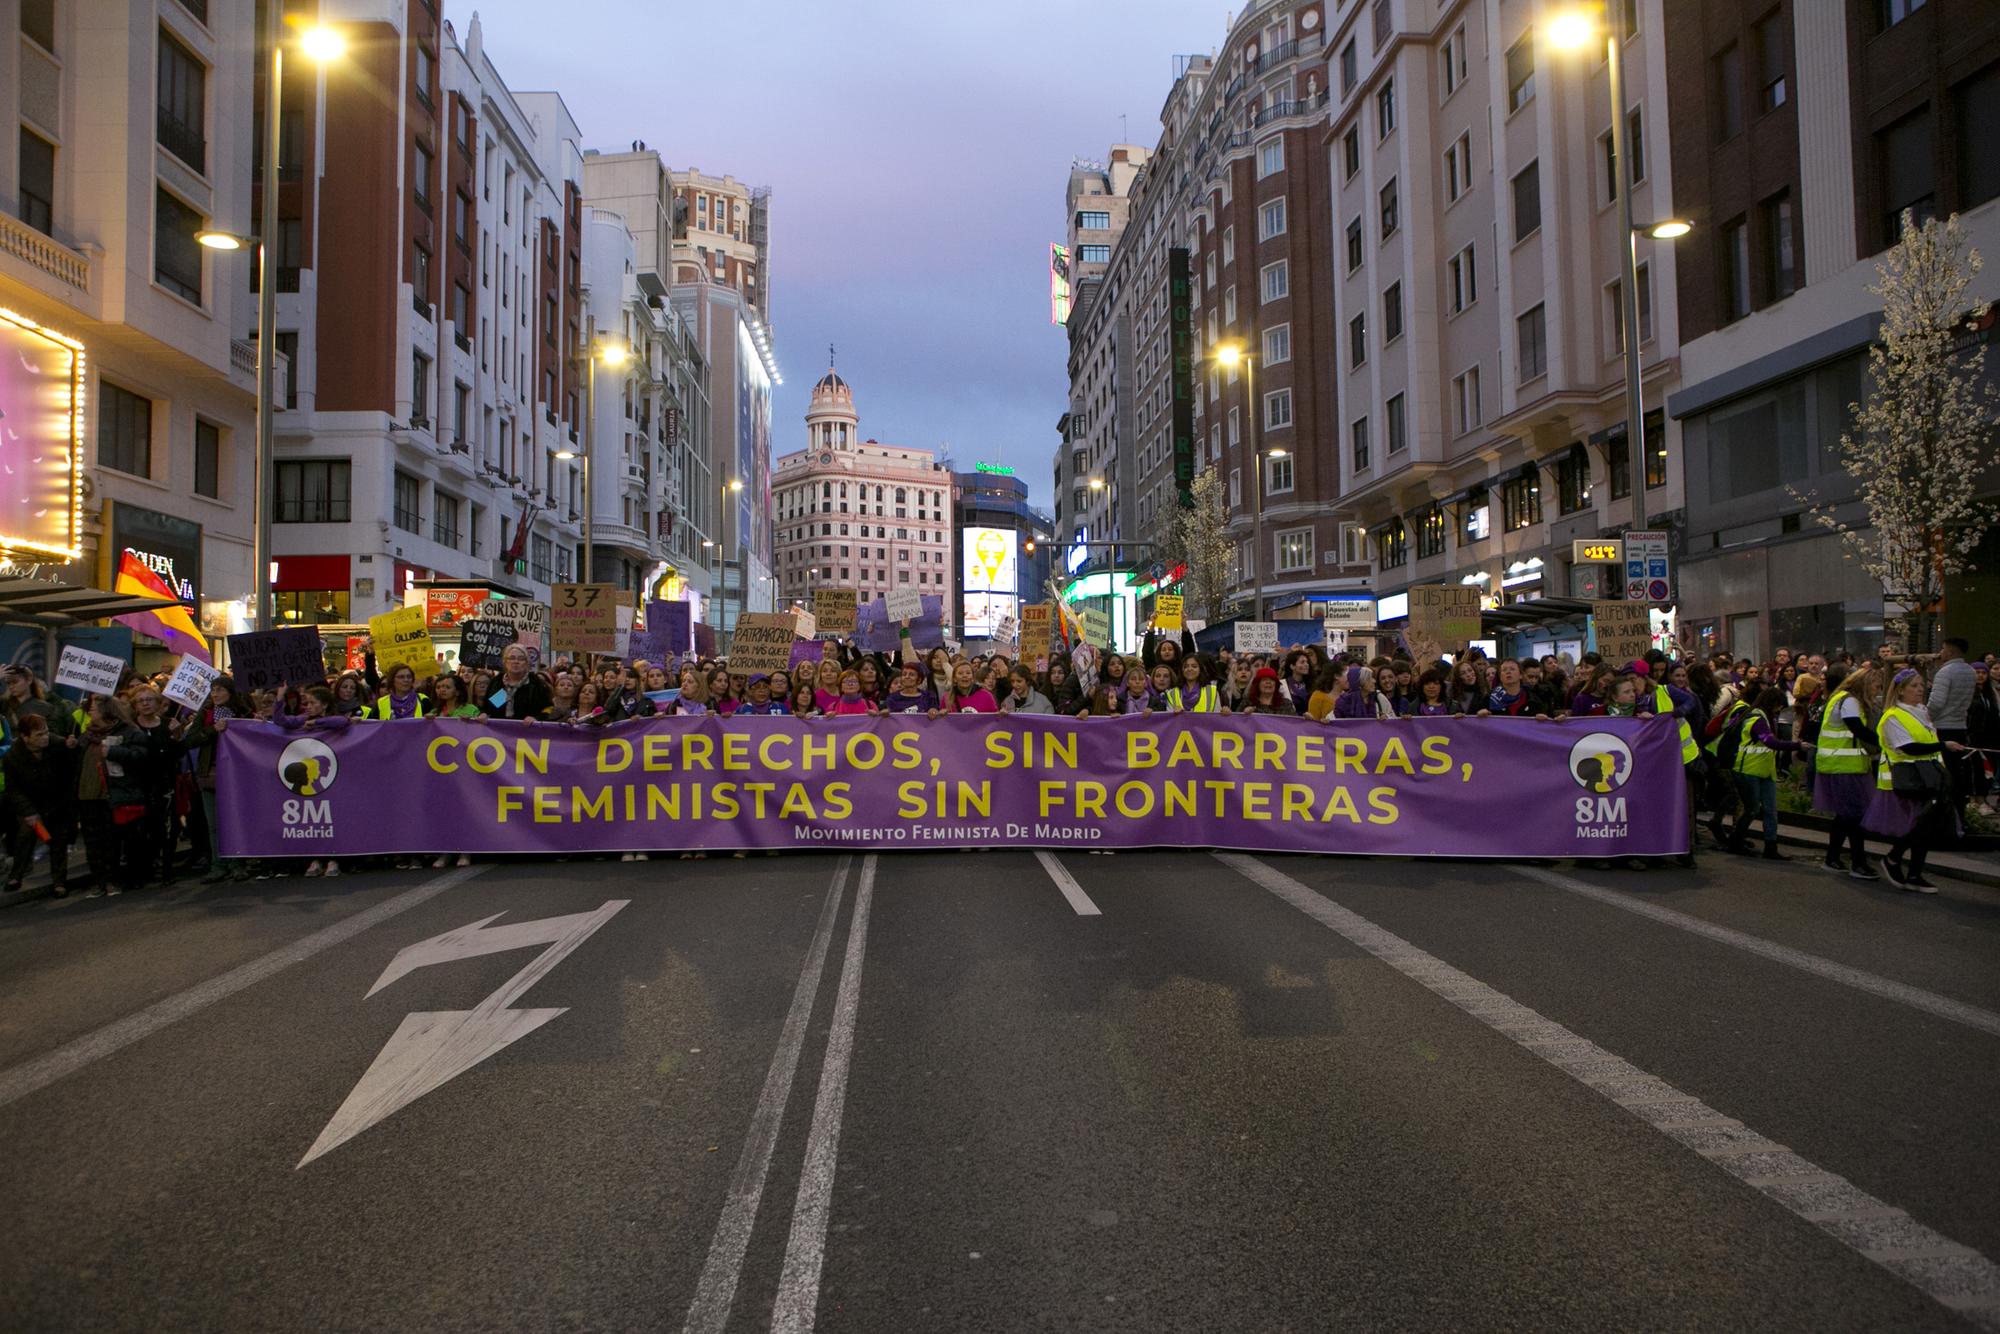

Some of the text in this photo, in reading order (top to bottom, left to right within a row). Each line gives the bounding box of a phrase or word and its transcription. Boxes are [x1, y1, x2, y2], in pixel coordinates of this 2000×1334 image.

[1173, 279, 1188, 400] HOTEL
[430, 592, 458, 600] MADRID
[564, 588, 601, 608] 37
[1412, 588, 1481, 606] JUSTICIA
[484, 602, 543, 622] GIRLS JUST
[739, 614, 754, 625] EL
[1025, 608, 1047, 619] SIN
[473, 621, 513, 637] VAMOS
[518, 620, 541, 633] HAVE
[394, 628, 427, 644] CALLADAS
[465, 632, 489, 644] CON
[79, 653, 87, 664] la
[1599, 645, 1615, 658] DEL
[728, 656, 788, 670] CORONAVIRUS
[58, 666, 67, 677] ni
[91, 674, 98, 684] ni
[99, 675, 115, 689] más!
[177, 672, 188, 682] DE
[427, 731, 1473, 782] CON DERECHOS, SIN BARRERAS,
[498, 780, 1398, 825] FEMINISTAS SIN FRONTERAS
[1575, 796, 1628, 824] 8M
[282, 798, 333, 825] 8M
[282, 824, 334, 839] Madrid
[795, 824, 907, 841] MOVIMIENTO
[912, 825, 1001, 841] FEMINISTA
[1034, 823, 1102, 840] MADRID
[1575, 824, 1628, 839] Madrid
